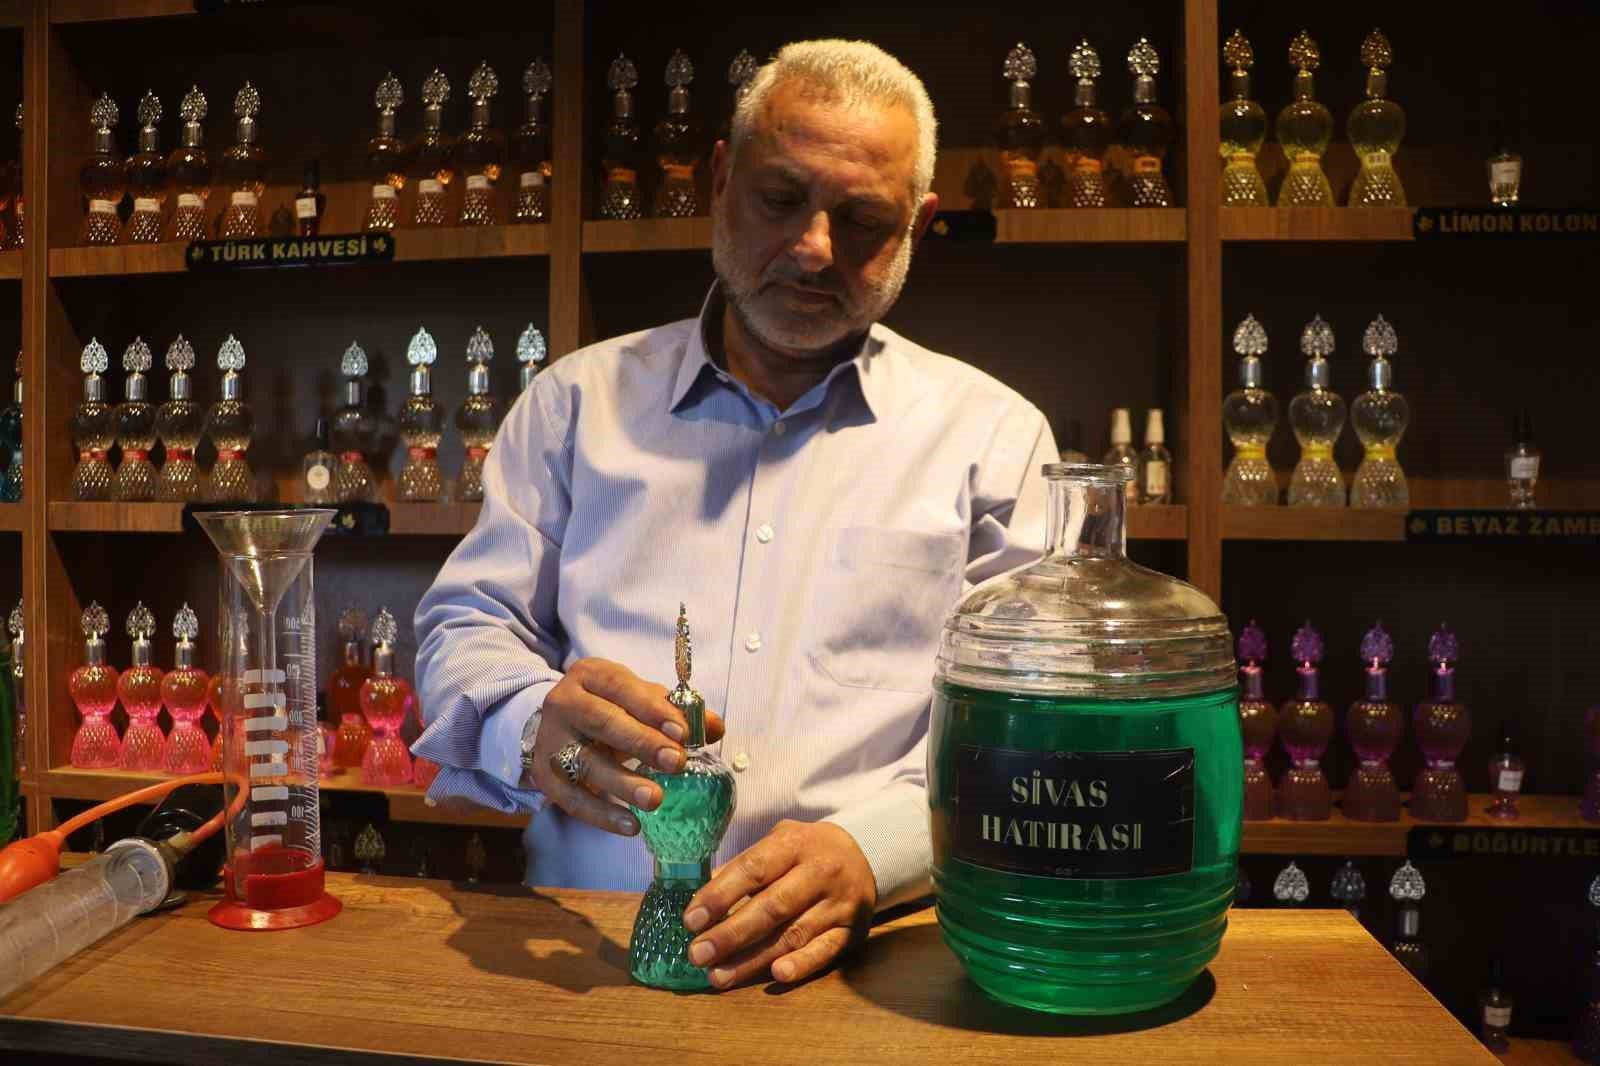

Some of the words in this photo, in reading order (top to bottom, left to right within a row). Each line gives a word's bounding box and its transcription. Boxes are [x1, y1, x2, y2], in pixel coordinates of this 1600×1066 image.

[1440, 209, 1513, 233] LİMON
[209, 241, 265, 262] TÜRK
[272, 235, 368, 258] KAHVESİ
[1437, 516, 1520, 536] BEYAZ
[1010, 768, 1110, 808] SİVAS
[980, 814, 1144, 851] HATIRASI
